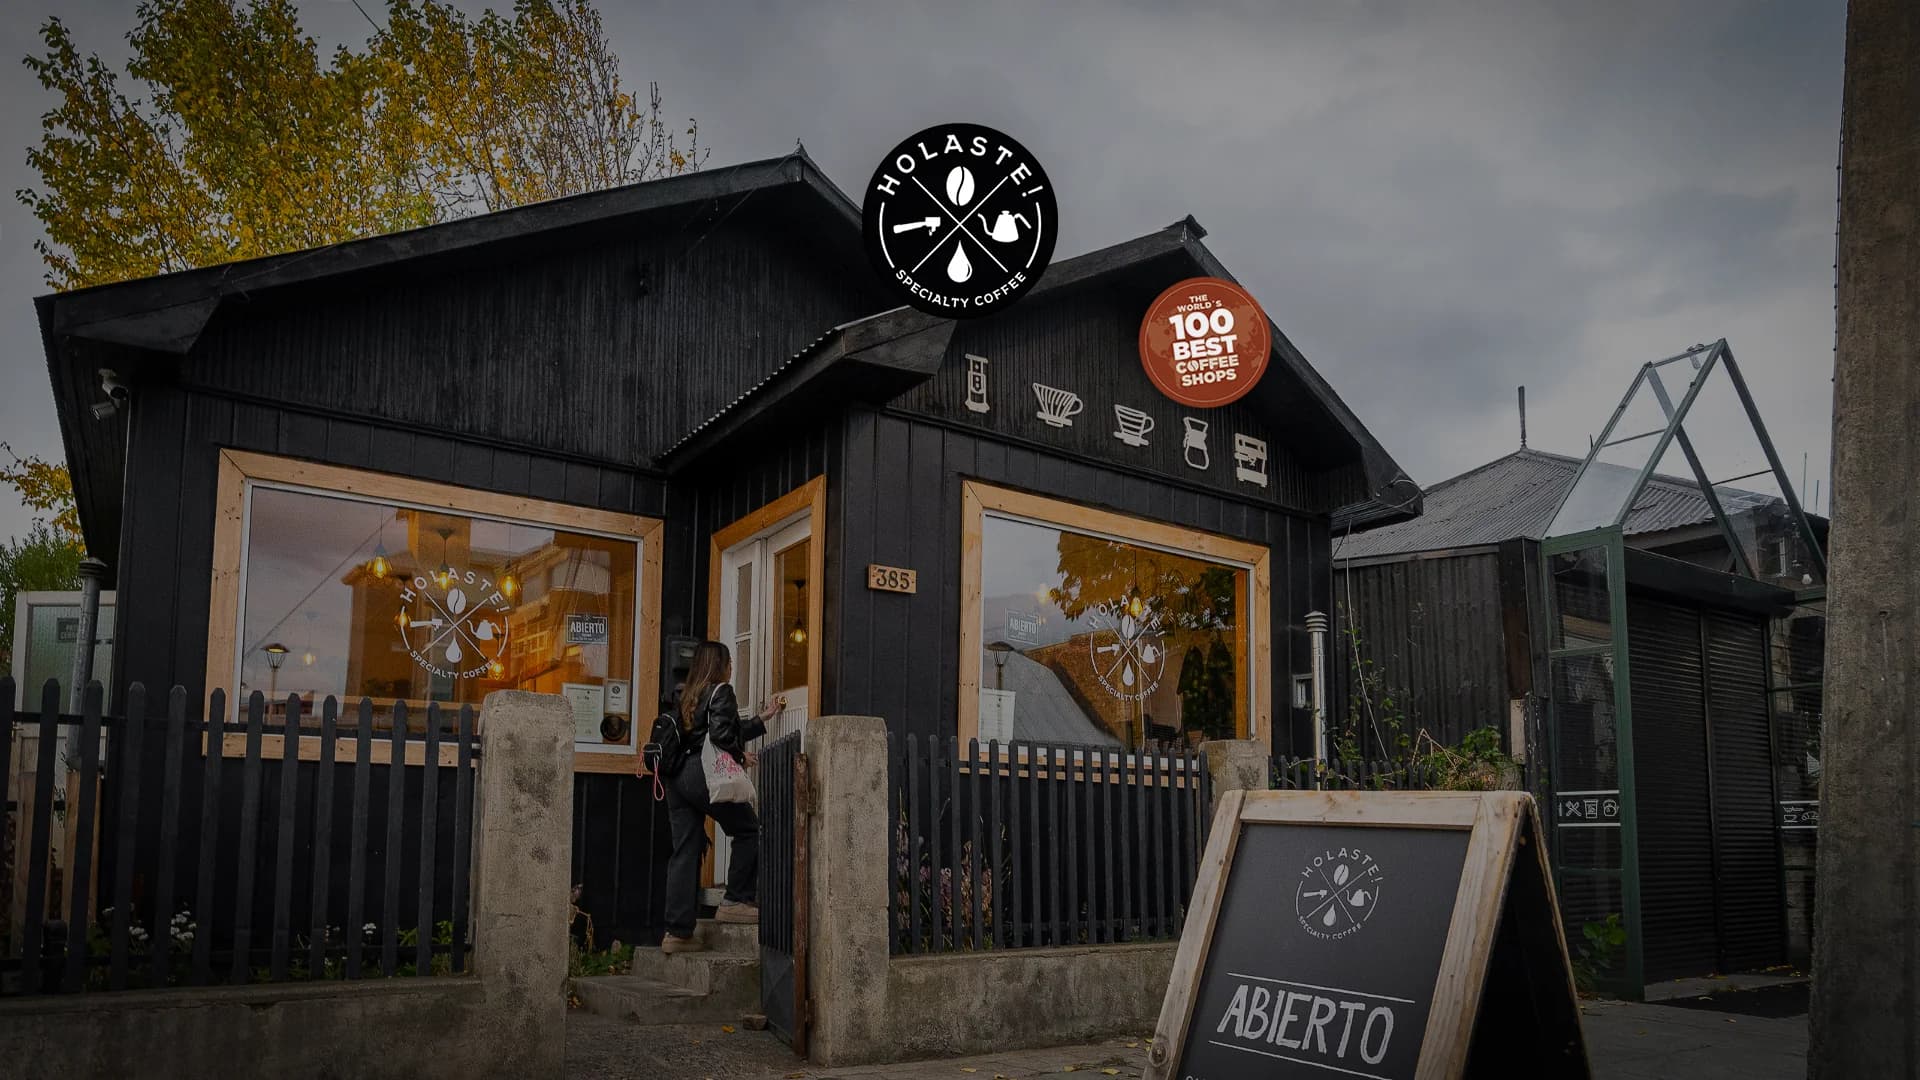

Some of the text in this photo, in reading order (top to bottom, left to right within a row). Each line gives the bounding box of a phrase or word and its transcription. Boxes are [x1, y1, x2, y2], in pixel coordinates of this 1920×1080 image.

[400, 567, 511, 613] HOLASTE!
[876, 569, 909, 589] 385
[570, 622, 604, 634] ABIERTO
[411, 651, 459, 679] SPECIALTY
[1098, 675, 1159, 701] SPECIALTY COFFEE
[1301, 847, 1384, 883] HOLASTE!
[1216, 984, 1394, 1065] ABIERTO
